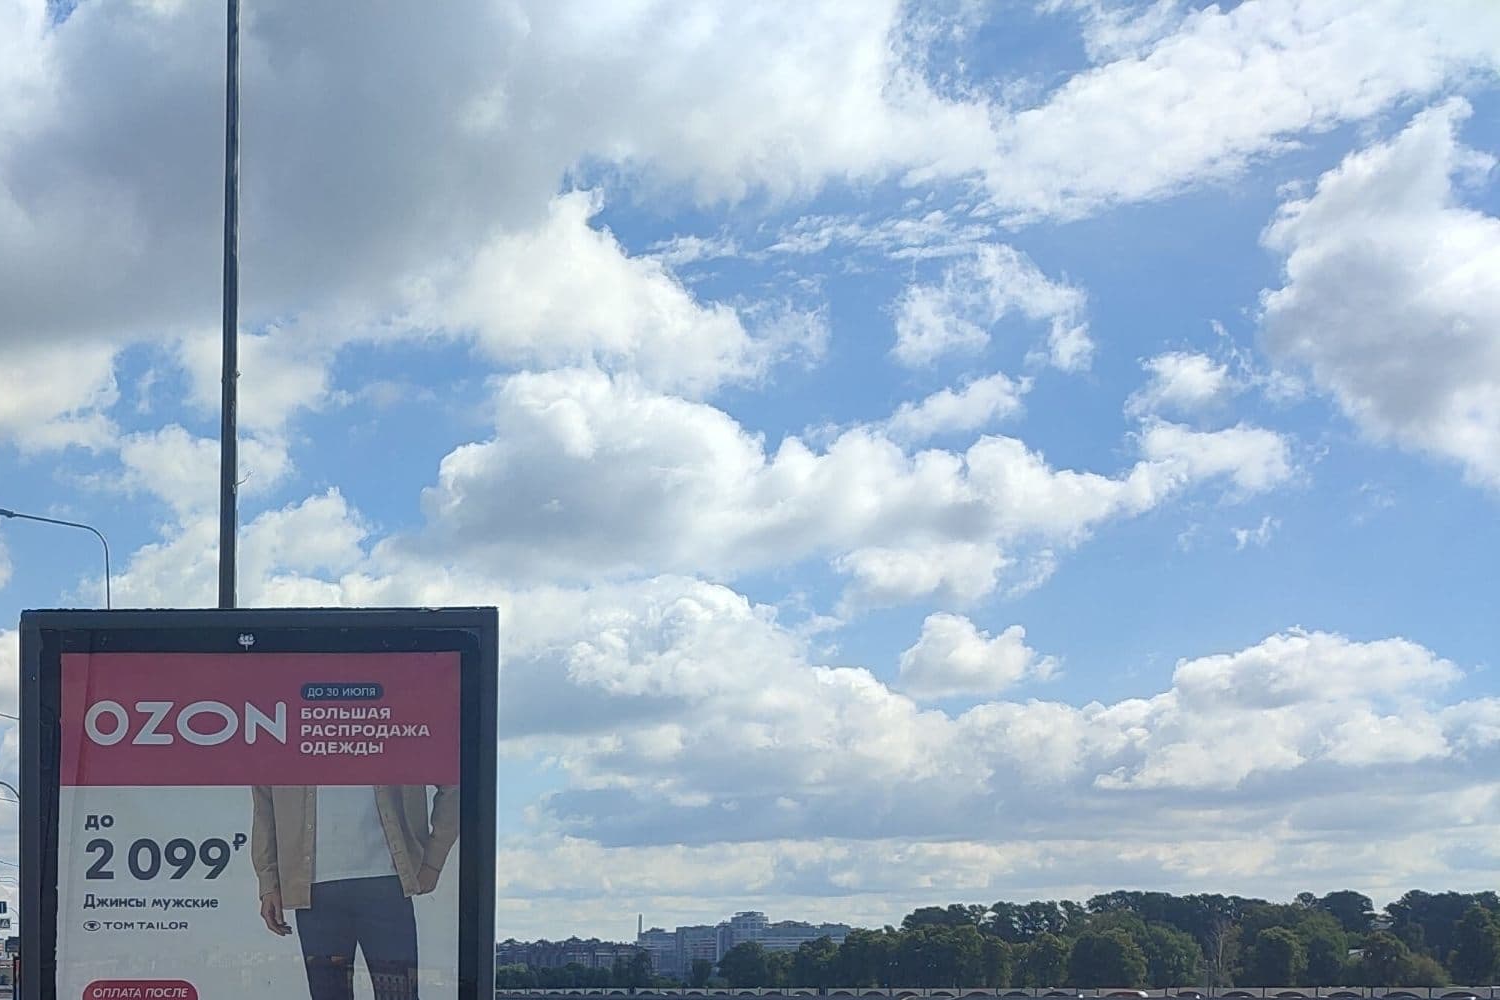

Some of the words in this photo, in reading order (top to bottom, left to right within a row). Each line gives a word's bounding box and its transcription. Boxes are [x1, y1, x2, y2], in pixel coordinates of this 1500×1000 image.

[307, 687, 324, 698] ДО
[326, 687, 339, 697] 30
[342, 687, 376, 697] ИЮЛЯ
[300, 707, 391, 720] БОЛЬШАЯ
[84, 700, 287, 746] OZON
[300, 724, 431, 739] РАСПРОДАЖА
[300, 741, 384, 756] ОДЕЖДЫ
[83, 893, 146, 909] Джинсы
[151, 898, 219, 911] мужские
[102, 921, 134, 930] TOM
[137, 921, 189, 930] TAILOR
[93, 988, 142, 998] ОПЛАТА
[145, 988, 189, 998] ПОСЛЕ
